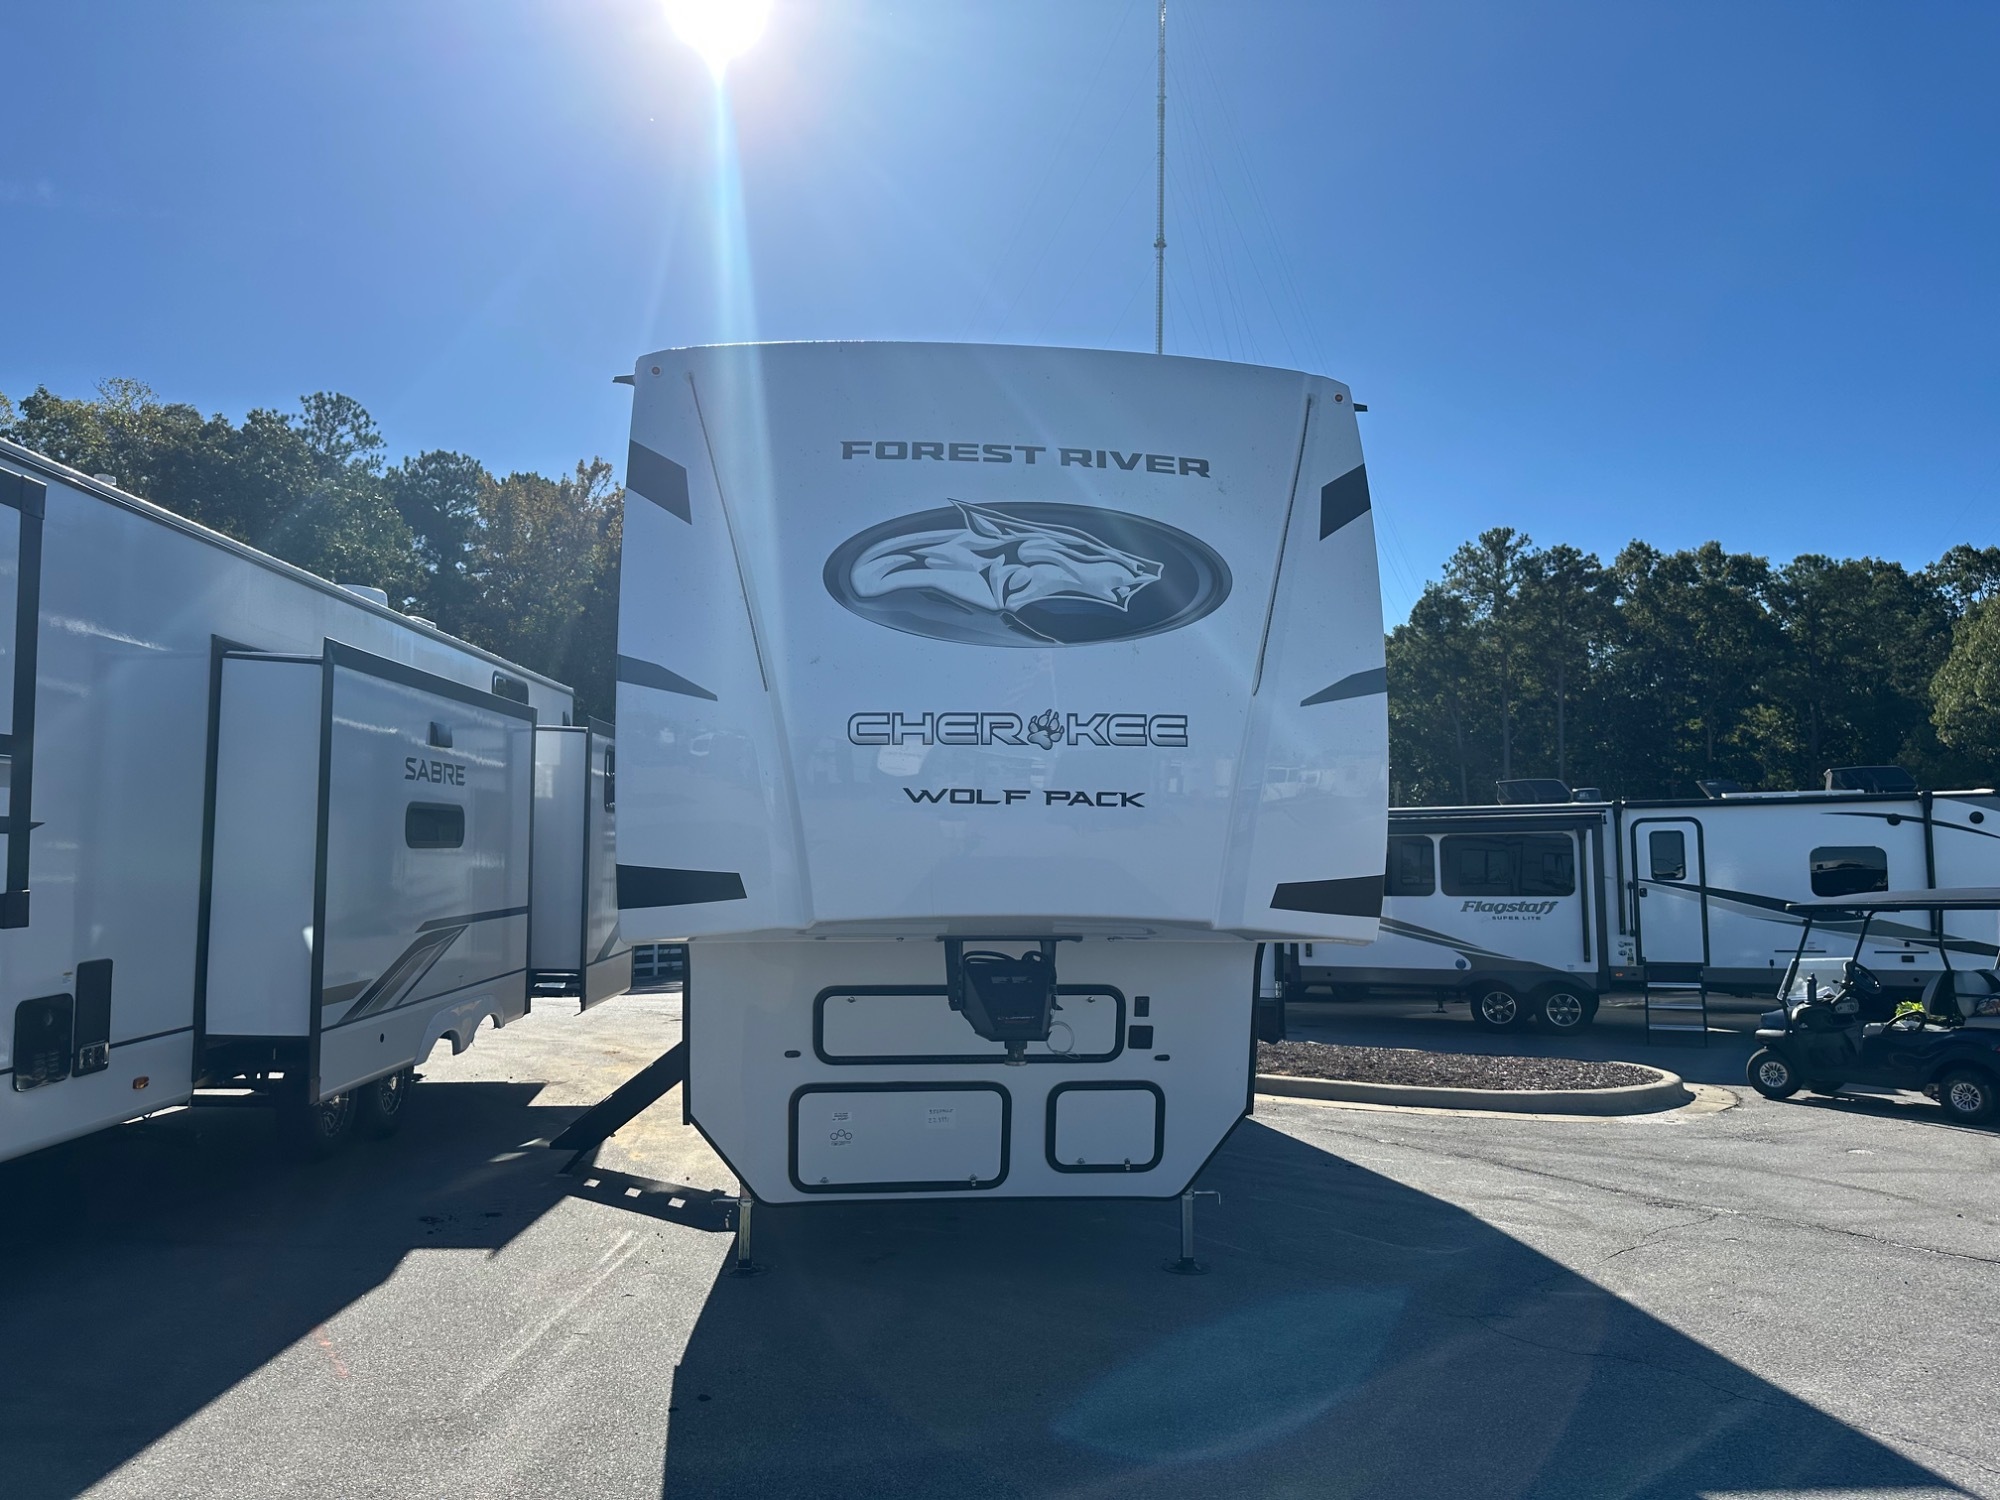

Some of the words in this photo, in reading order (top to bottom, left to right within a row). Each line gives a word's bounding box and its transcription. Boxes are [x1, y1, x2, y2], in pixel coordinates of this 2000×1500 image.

[841, 441, 1047, 465] FOREST
[1058, 448, 1211, 479] RIVER
[404, 757, 467, 786] SABRE
[903, 787, 1031, 806] WOLF
[1042, 790, 1146, 808] PACK
[1460, 900, 1560, 915] Flagstaff
